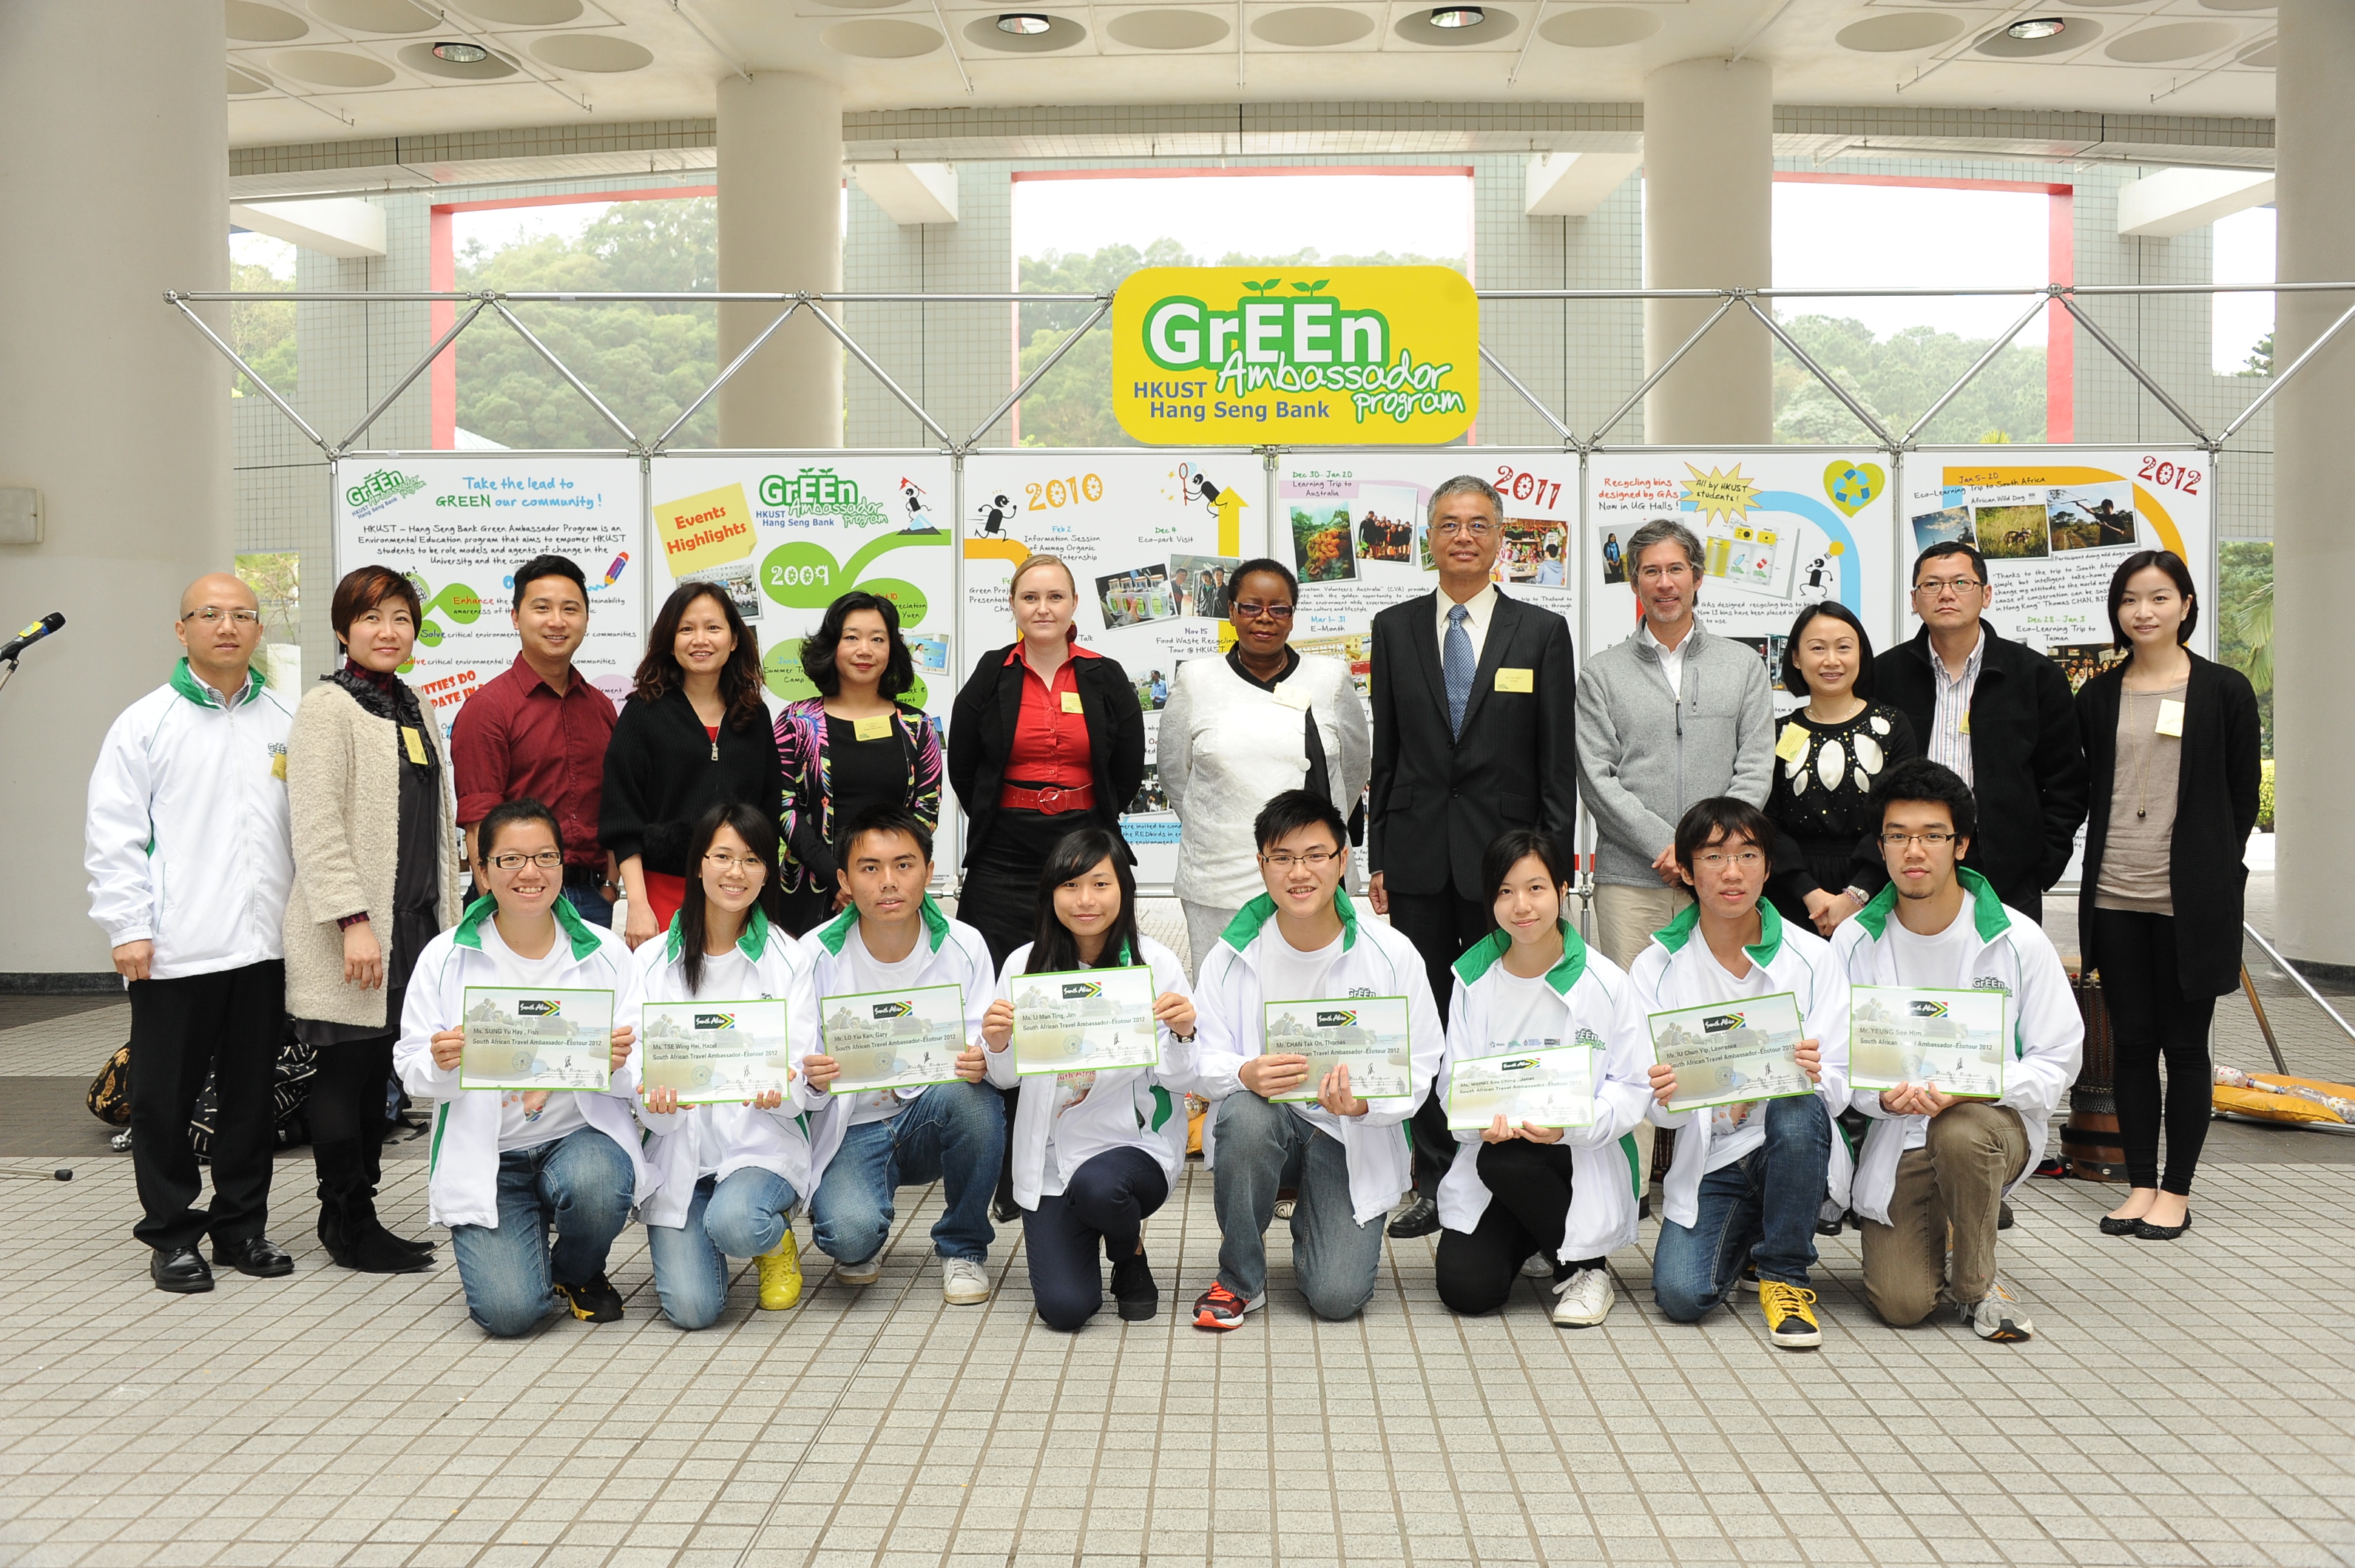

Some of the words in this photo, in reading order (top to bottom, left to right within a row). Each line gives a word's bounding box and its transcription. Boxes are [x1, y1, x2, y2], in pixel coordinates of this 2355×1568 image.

[1143, 295, 1388, 369] GrEEn
[1217, 349, 1451, 396] Ambassador
[1133, 382, 1207, 399] HKUST
[1151, 402, 1206, 422] Hang
[1214, 402, 1267, 422] Seng
[1276, 401, 1330, 418] Bank
[1354, 390, 1466, 424] program
[1959, 476, 1974, 484] Jan
[1988, 472, 1998, 480] 20
[2137, 455, 2201, 496] 2012
[462, 477, 498, 490] Take
[501, 477, 524, 490] the
[527, 477, 555, 490] lead
[560, 478, 574, 490] to
[1293, 481, 1324, 489] Learning
[1493, 465, 1561, 510] 2011
[1604, 478, 1651, 488] Recycling
[1653, 479, 1672, 487] bins
[1709, 481, 1717, 491] by
[1721, 482, 1748, 493] HKUST
[1913, 487, 1966, 499] Eco-Learning
[1968, 484, 1984, 492] Trip
[1996, 479, 2018, 487] South
[2021, 476, 2046, 485] Africa
[760, 475, 858, 507] GrEEn
[1025, 473, 1103, 511] 2010
[1598, 490, 1641, 500] designed
[1643, 490, 1654, 500] by
[1657, 490, 1679, 499] GAs
[1697, 490, 1734, 501] students
[436, 494, 491, 507] GREEN
[495, 499, 517, 507] our
[521, 496, 594, 510] community
[598, 493, 602, 507] !
[788, 496, 883, 517] Ambassador
[1598, 501, 1617, 510] Now
[1650, 501, 1672, 510] Halls
[675, 507, 726, 530] Events
[763, 519, 785, 528] Hang
[788, 519, 809, 527] Seng
[842, 514, 888, 528] program
[363, 524, 397, 533] HKUST
[409, 525, 430, 535] Hang
[433, 525, 455, 535] Seng
[458, 524, 478, 533] Bank
[509, 524, 560, 533] Ambassador
[563, 524, 598, 534] Program
[666, 523, 746, 555] Highlights
[1024, 535, 1069, 543] Information
[1138, 535, 1174, 544] Eco-park
[1039, 544, 1064, 552] Amway
[1067, 544, 1095, 553] Organic
[1059, 553, 1098, 561] Internship
[771, 565, 829, 586] 2009
[453, 596, 495, 605] Enhance
[420, 629, 447, 638] Solve
[2016, 626, 2068, 634] Eco-Learning
[2071, 625, 2086, 633] Trip
[1078, 634, 1094, 642] Talk
[1711, 1044, 1737, 1052] Lawrence
